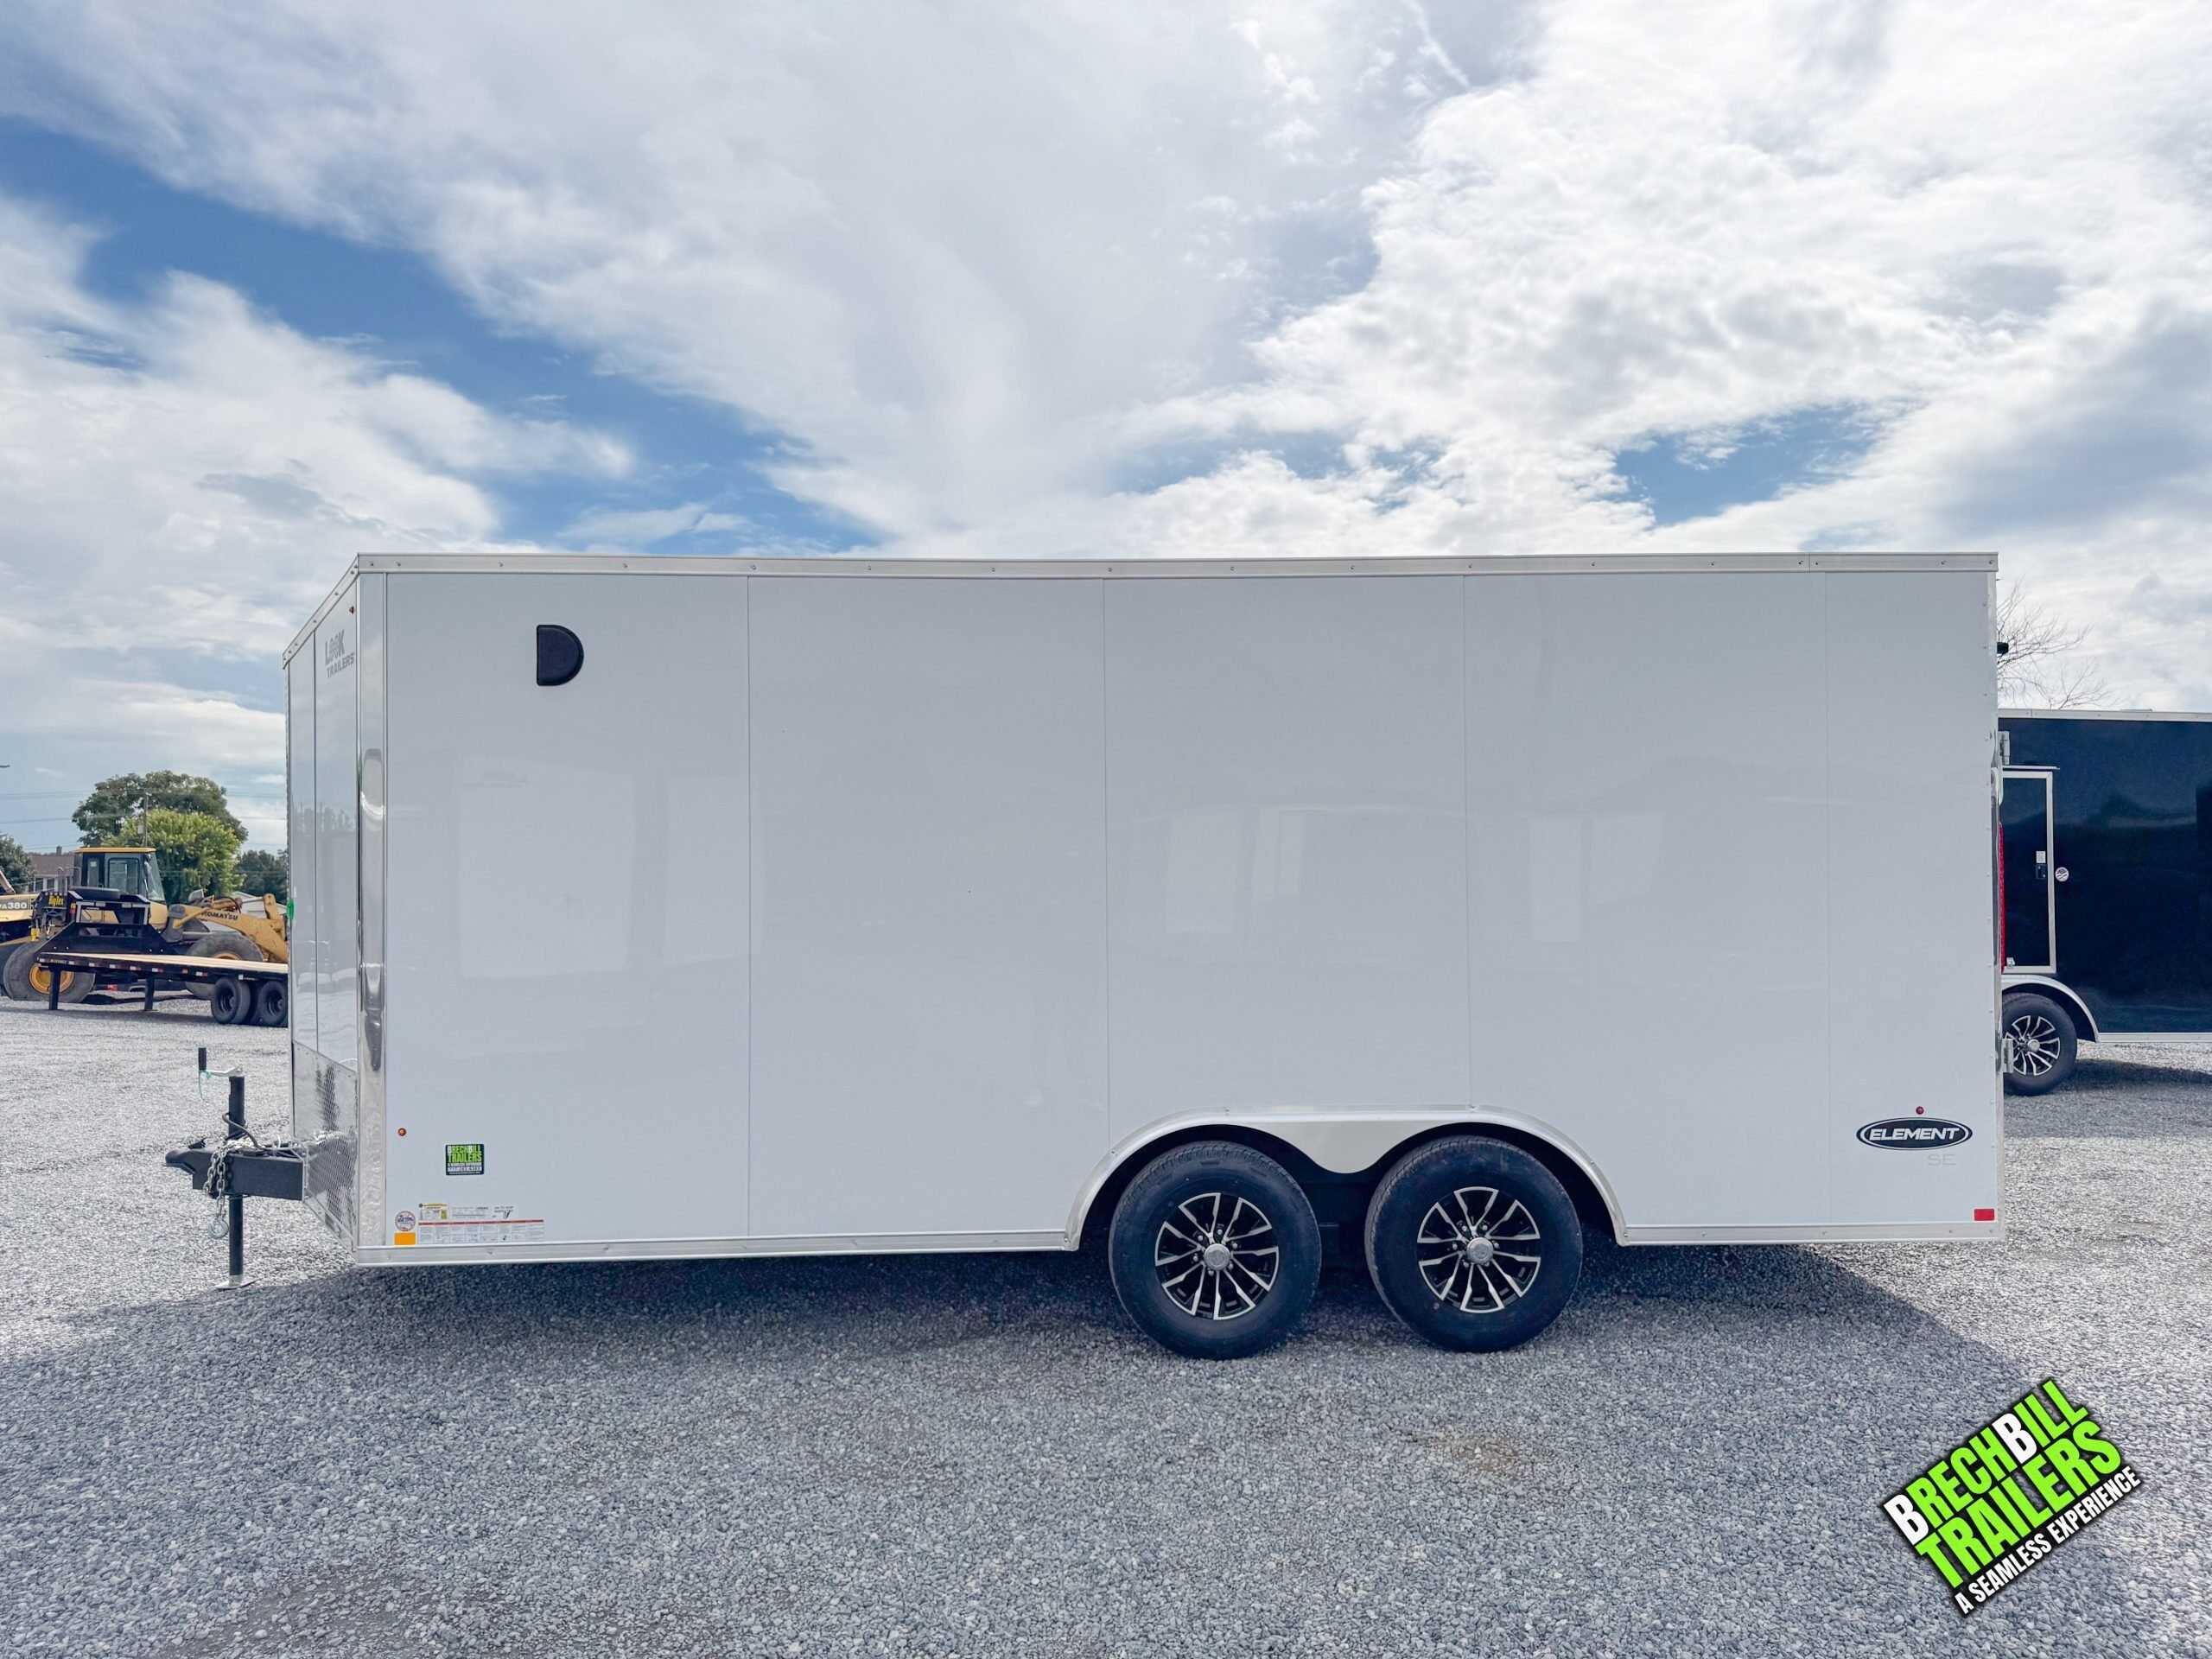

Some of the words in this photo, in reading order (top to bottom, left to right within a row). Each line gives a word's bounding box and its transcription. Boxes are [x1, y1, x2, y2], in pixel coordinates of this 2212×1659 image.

[327, 652, 355, 677] TRAILERS
[1869, 1128, 1960, 1141] ELEMENT
[448, 1153, 482, 1163] TRAILERS
[1927, 1154, 1957, 1166] SE
